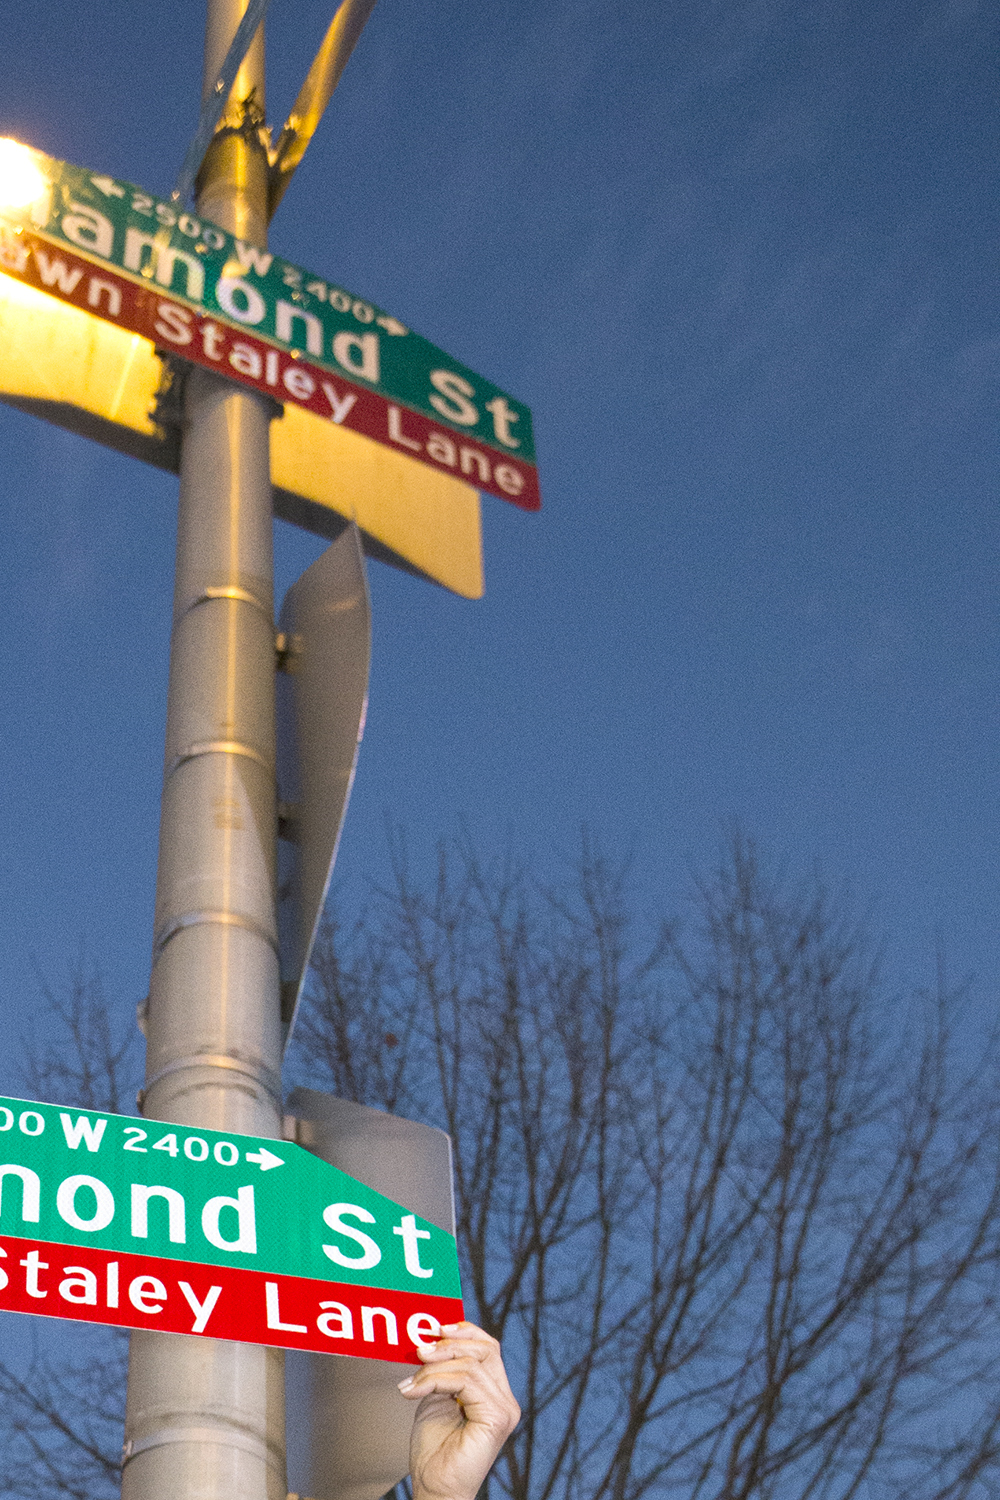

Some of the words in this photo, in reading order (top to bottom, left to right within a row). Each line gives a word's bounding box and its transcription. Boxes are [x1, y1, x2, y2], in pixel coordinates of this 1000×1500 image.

[131, 192, 226, 250] 2500
[235, 239, 274, 277] W
[282, 265, 375, 325] 2400
[154, 303, 357, 425] Staley
[388, 406, 526, 497] Lane
[427, 368, 520, 449] St
[60, 1113, 107, 1153] W
[123, 1127, 239, 1166] 2400
[322, 1203, 433, 1279] St
[265, 1281, 440, 1349] Lane
